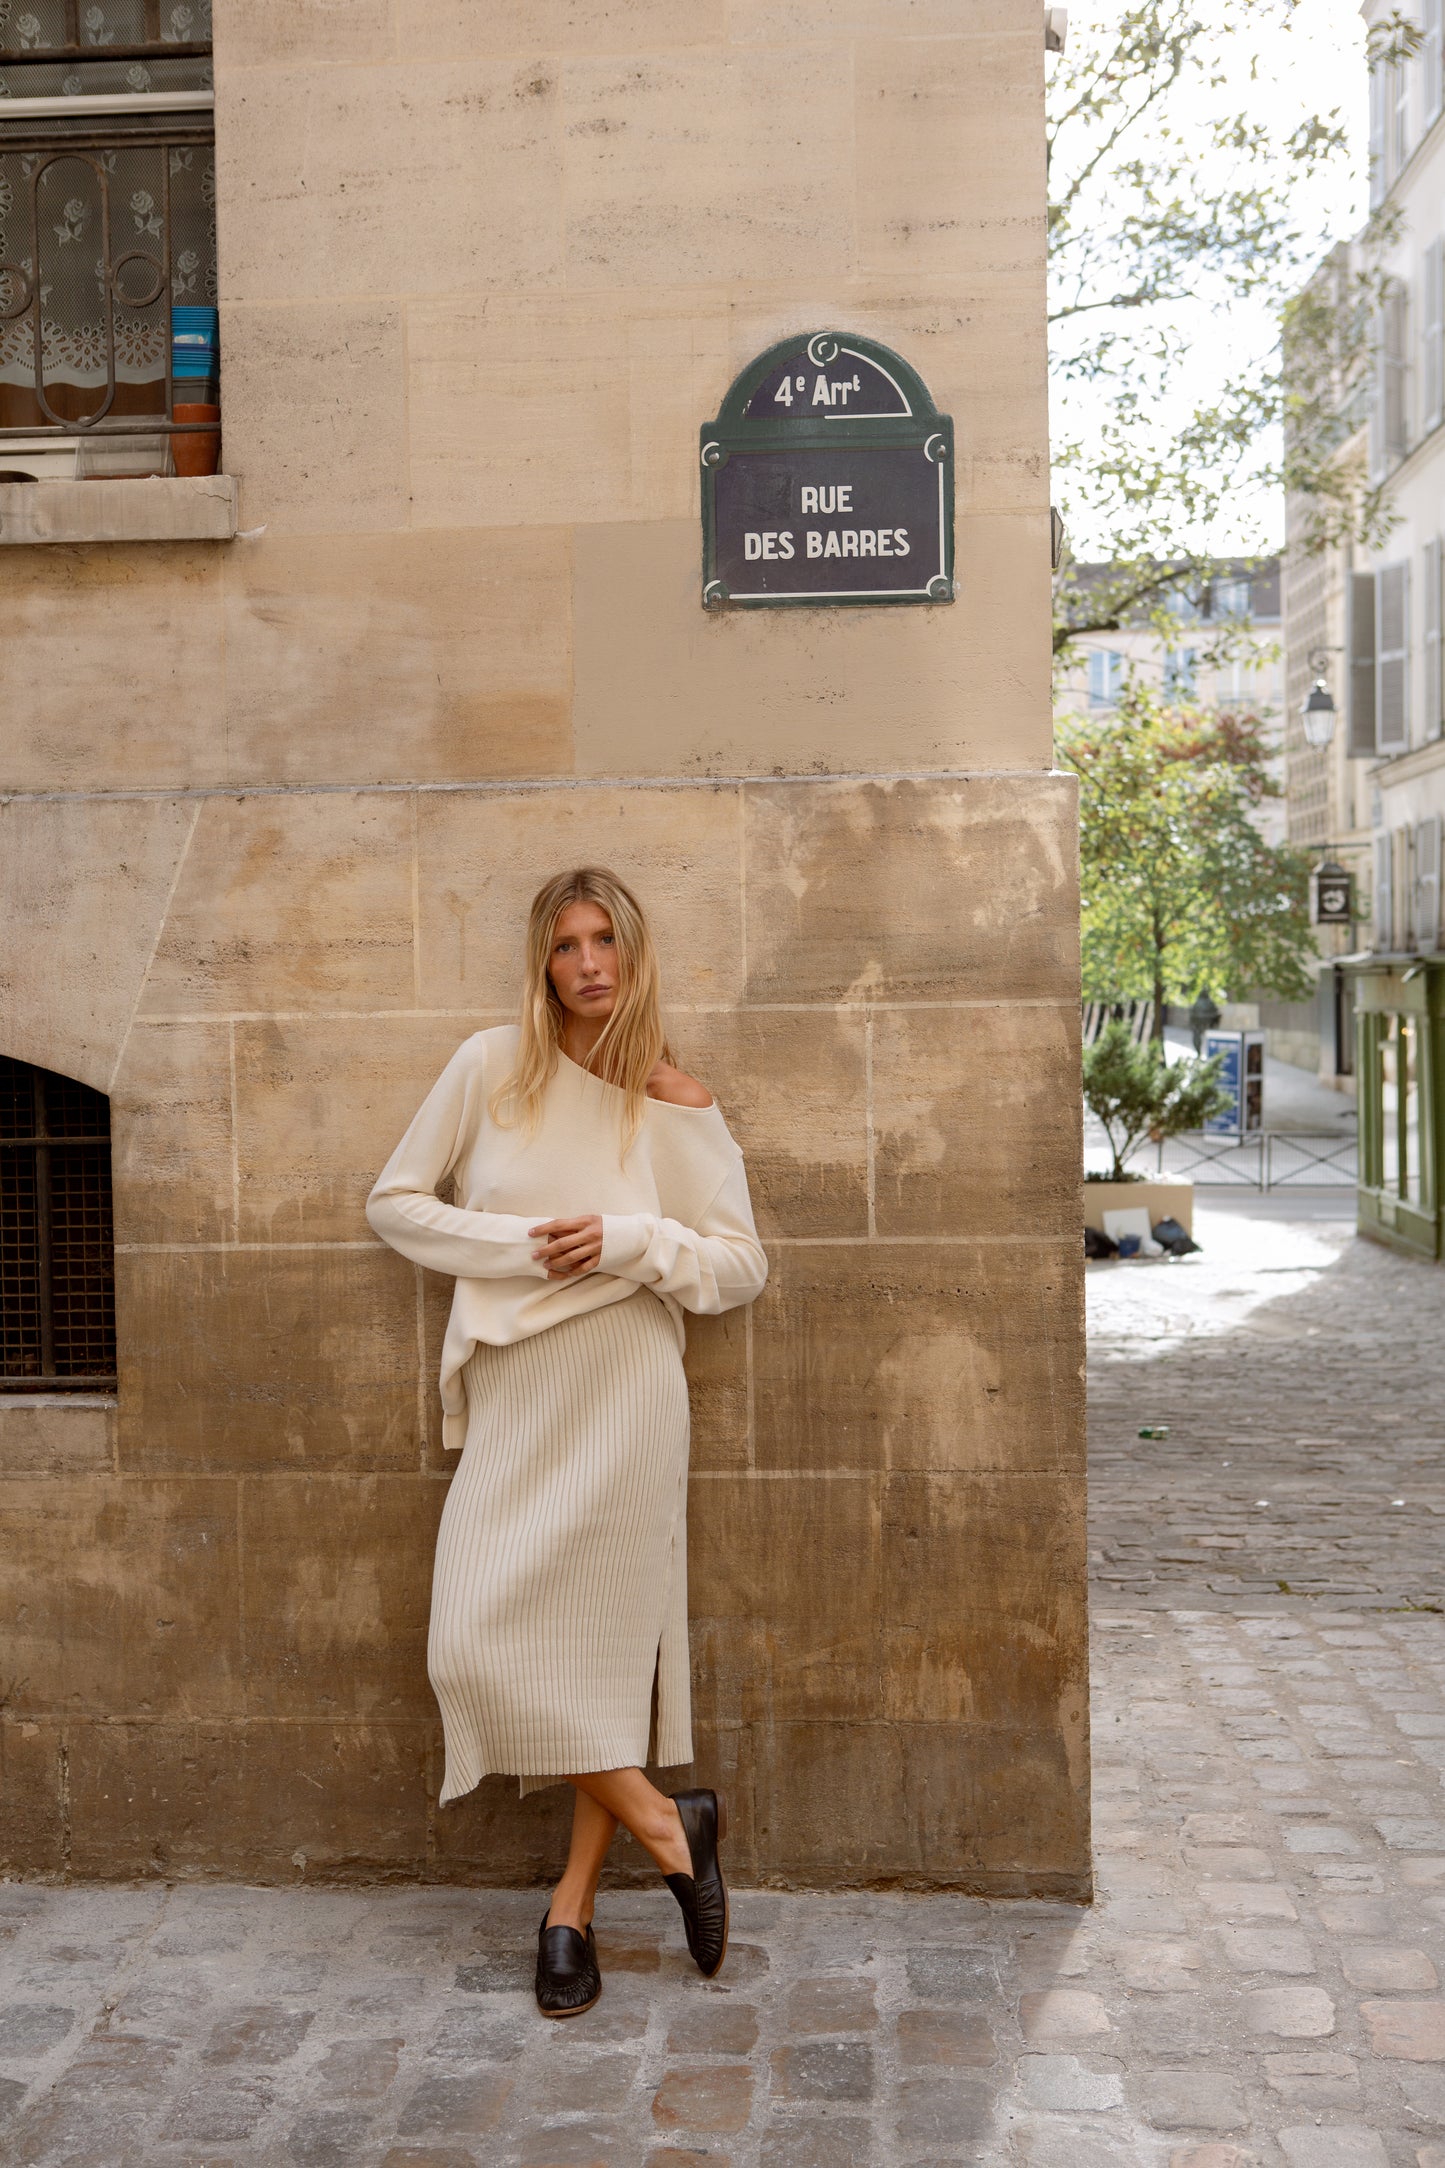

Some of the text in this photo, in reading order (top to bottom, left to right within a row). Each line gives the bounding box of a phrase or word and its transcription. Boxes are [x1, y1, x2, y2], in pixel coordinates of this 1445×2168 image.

[801, 485, 853, 514] RUE
[744, 528, 911, 561] DES BARRES
